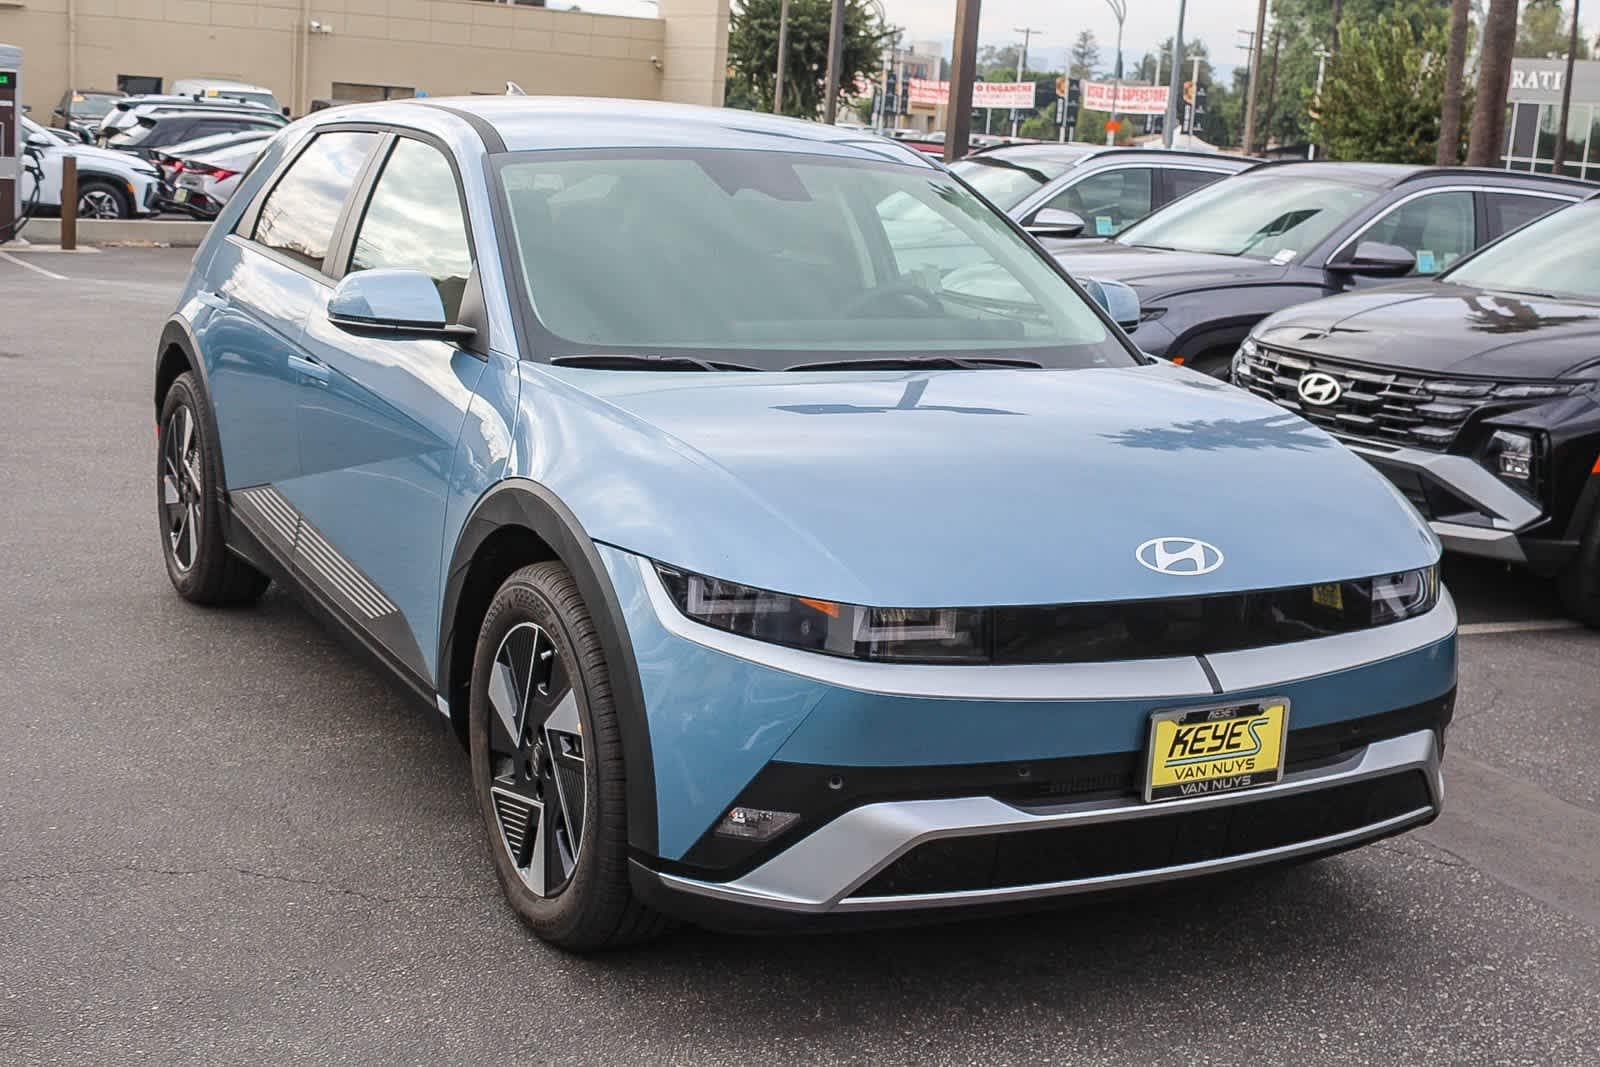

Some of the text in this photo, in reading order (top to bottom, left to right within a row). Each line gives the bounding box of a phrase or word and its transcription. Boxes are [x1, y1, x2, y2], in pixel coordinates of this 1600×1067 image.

[1167, 717, 1270, 759] KEYES
[1174, 758, 1256, 780] VAN NUYS
[1180, 775, 1252, 795] VAN NUYS
